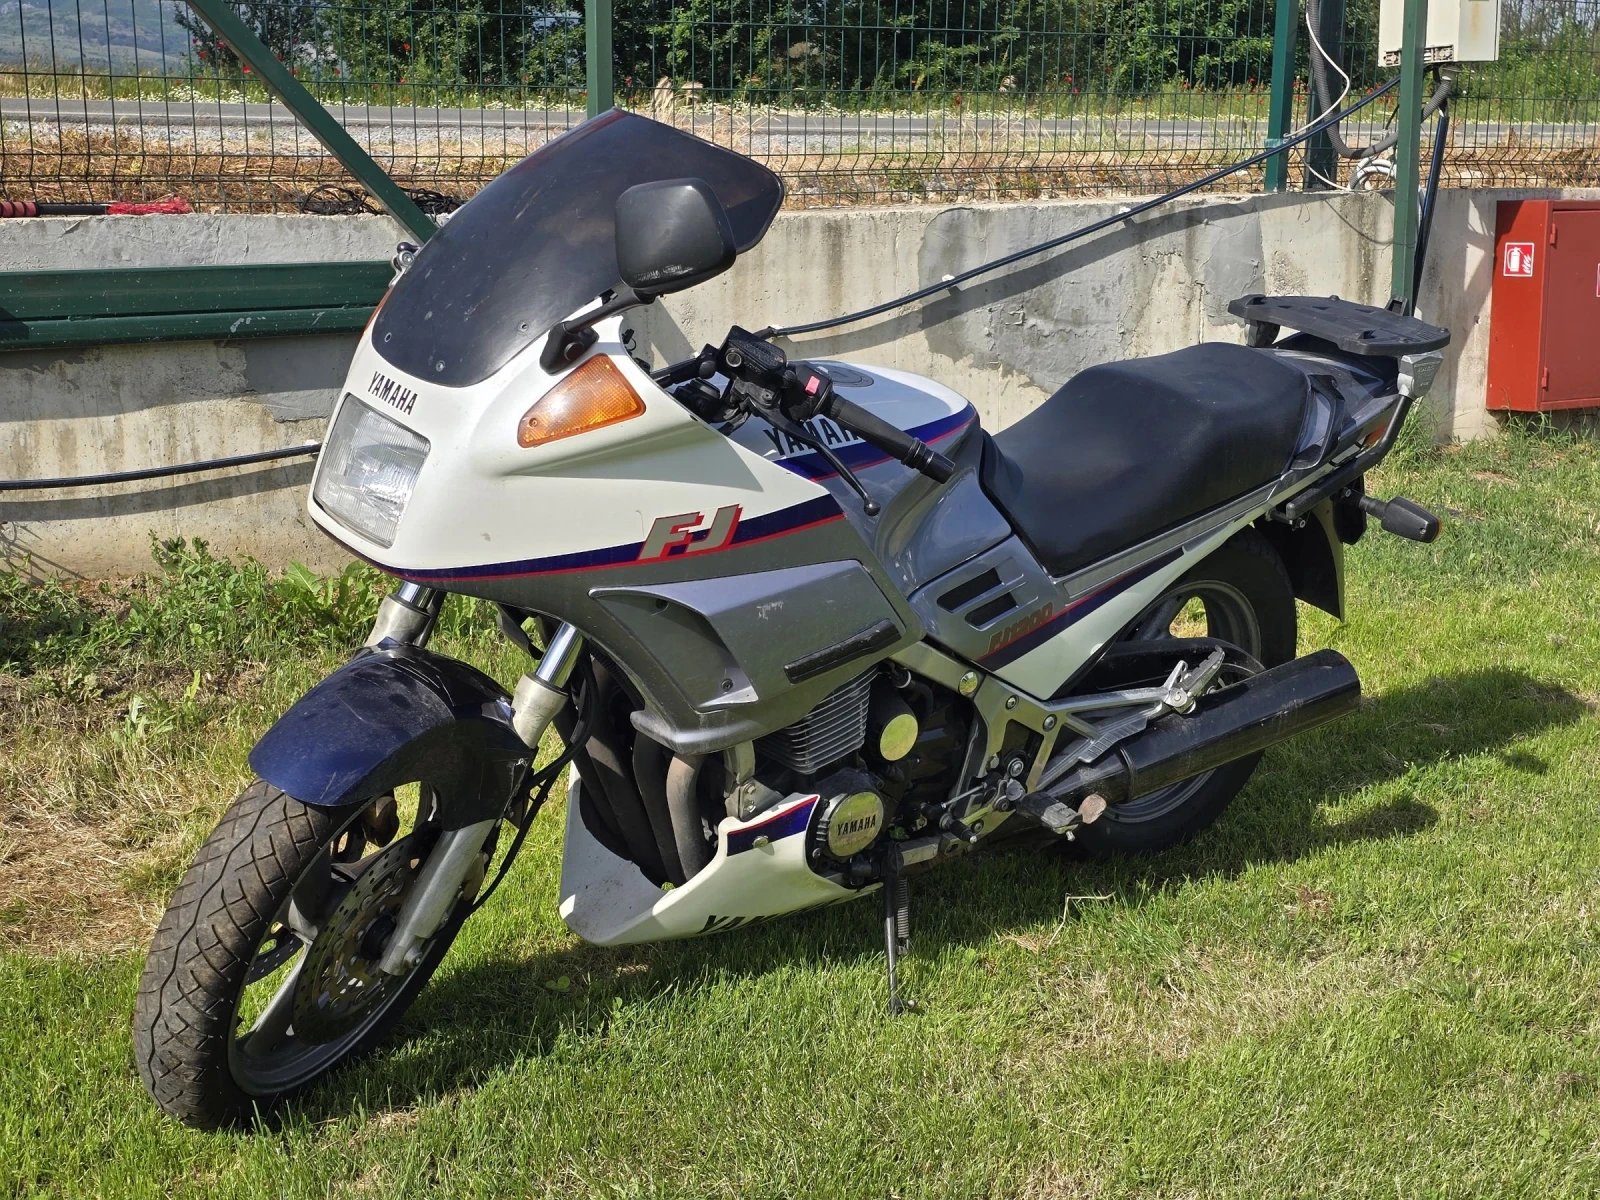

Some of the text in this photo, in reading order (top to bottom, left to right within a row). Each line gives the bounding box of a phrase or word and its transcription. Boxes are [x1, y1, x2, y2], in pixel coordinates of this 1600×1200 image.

[367, 371, 419, 415] YAMAHA
[763, 418, 860, 456] YAMA
[637, 503, 743, 560] FJ
[836, 814, 877, 836] YAMAHA
